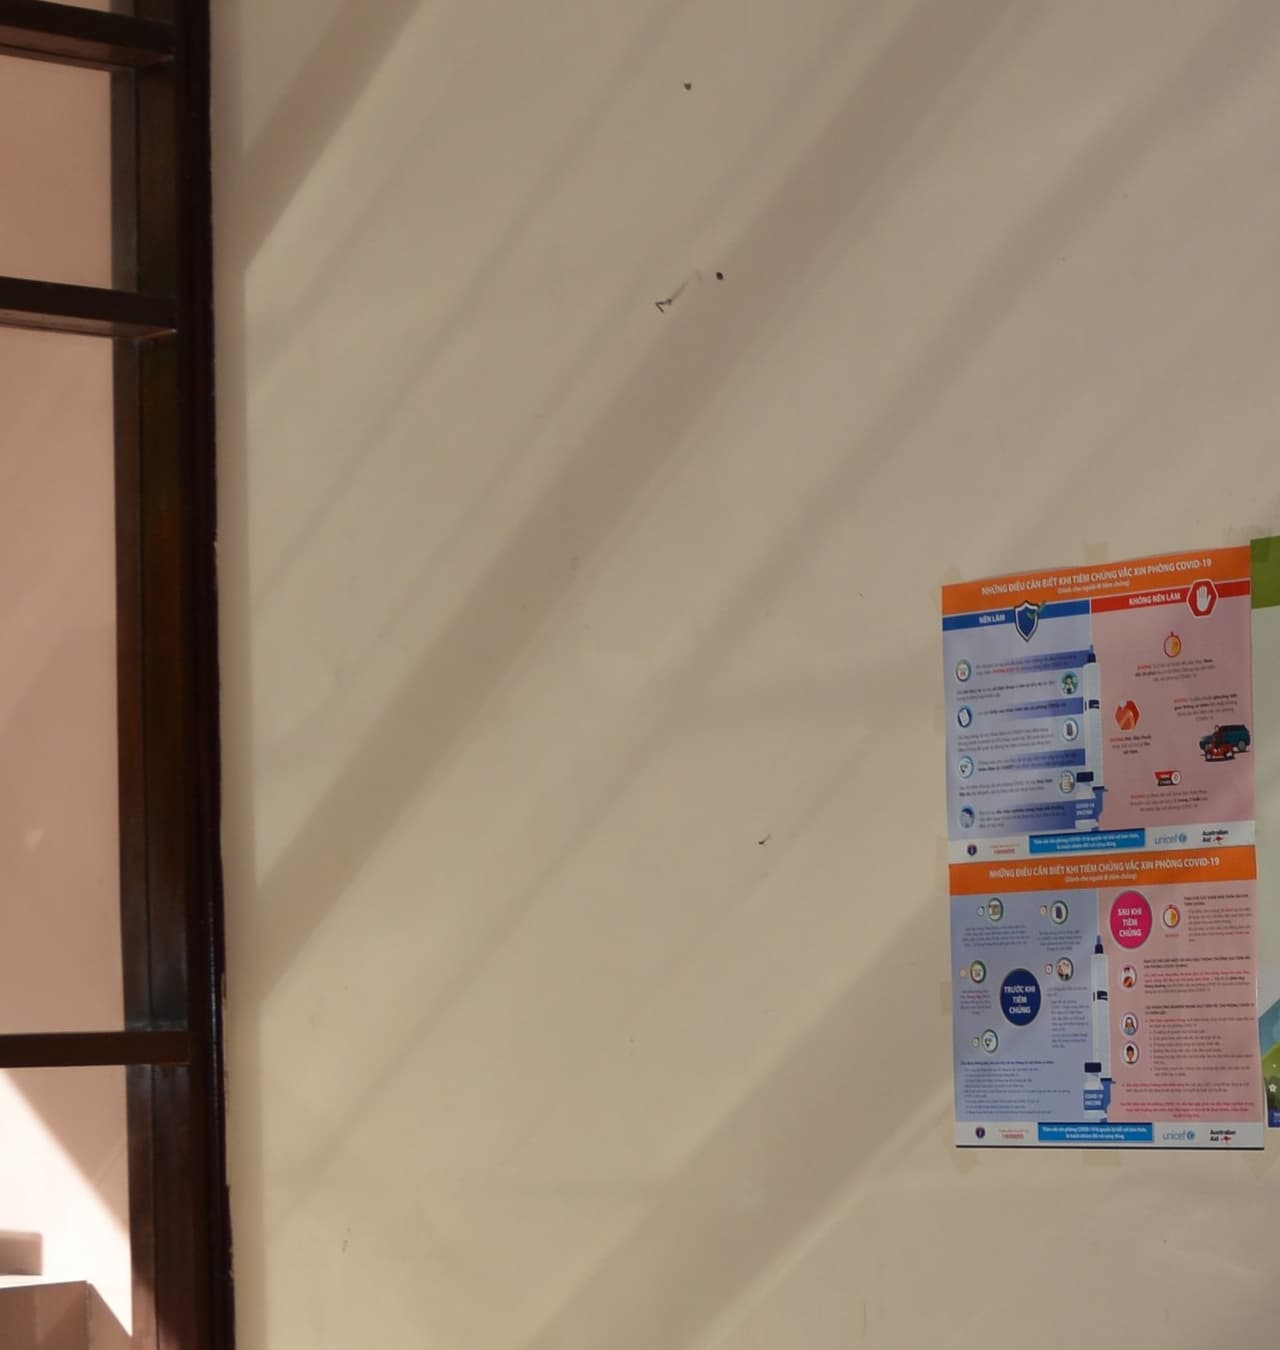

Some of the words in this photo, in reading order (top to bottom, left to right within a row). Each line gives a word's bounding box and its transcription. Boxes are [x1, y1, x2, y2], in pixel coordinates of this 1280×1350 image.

[1176, 558, 1213, 571] COVID-19
[1166, 591, 1181, 601] LÀM
[1184, 856, 1220, 867] COVID-19
[1118, 907, 1130, 916] SAU
[1131, 907, 1143, 915] KHI
[1122, 917, 1138, 926] TIÊM
[1119, 927, 1143, 938] CHỦNG
[1003, 984, 1024, 993] TRƯỚC
[1025, 985, 1036, 993] KHI
[1012, 994, 1028, 1004] TIÊM
[1009, 1004, 1031, 1015] CHỦNG
